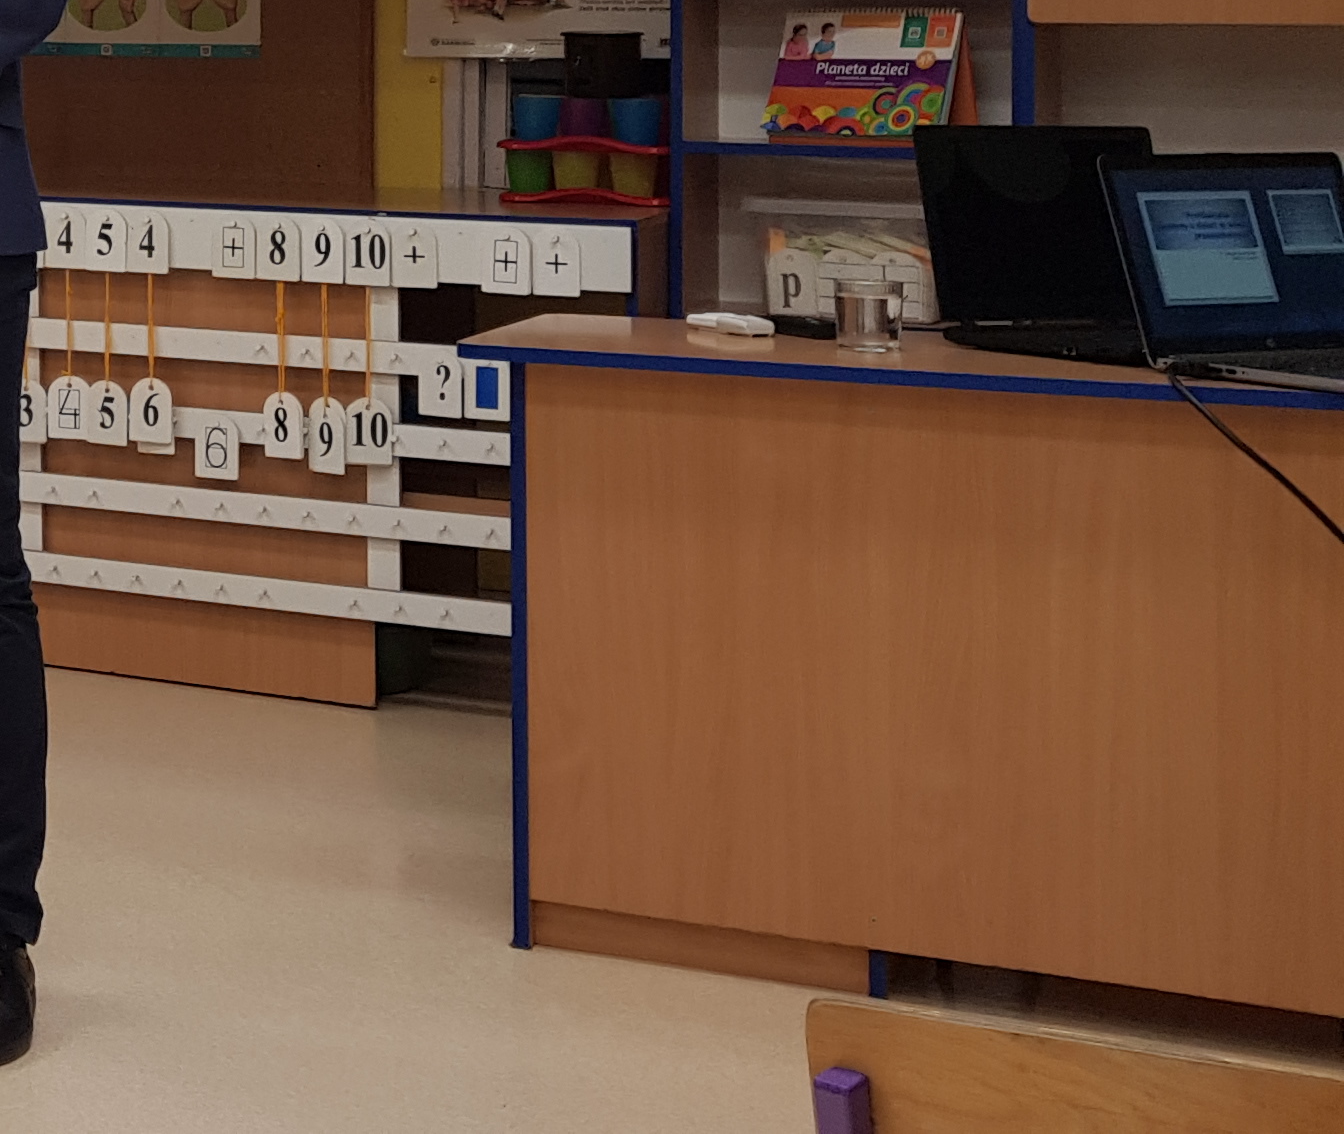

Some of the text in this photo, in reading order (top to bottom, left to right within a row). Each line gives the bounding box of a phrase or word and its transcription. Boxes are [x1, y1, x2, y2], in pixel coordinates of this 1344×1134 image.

[815, 62, 909, 76] Planeta dzieci
[57, 221, 73, 254] 4
[96, 223, 114, 256] 5
[138, 224, 155, 258] 4
[269, 229, 286, 265] 8
[314, 232, 331, 267] 9
[350, 233, 386, 270] 10
[780, 272, 802, 309] p
[435, 364, 451, 401] ?
[19, 389, 389, 458] 3 4 5 6 8 9 10
[205, 426, 228, 469] 6
